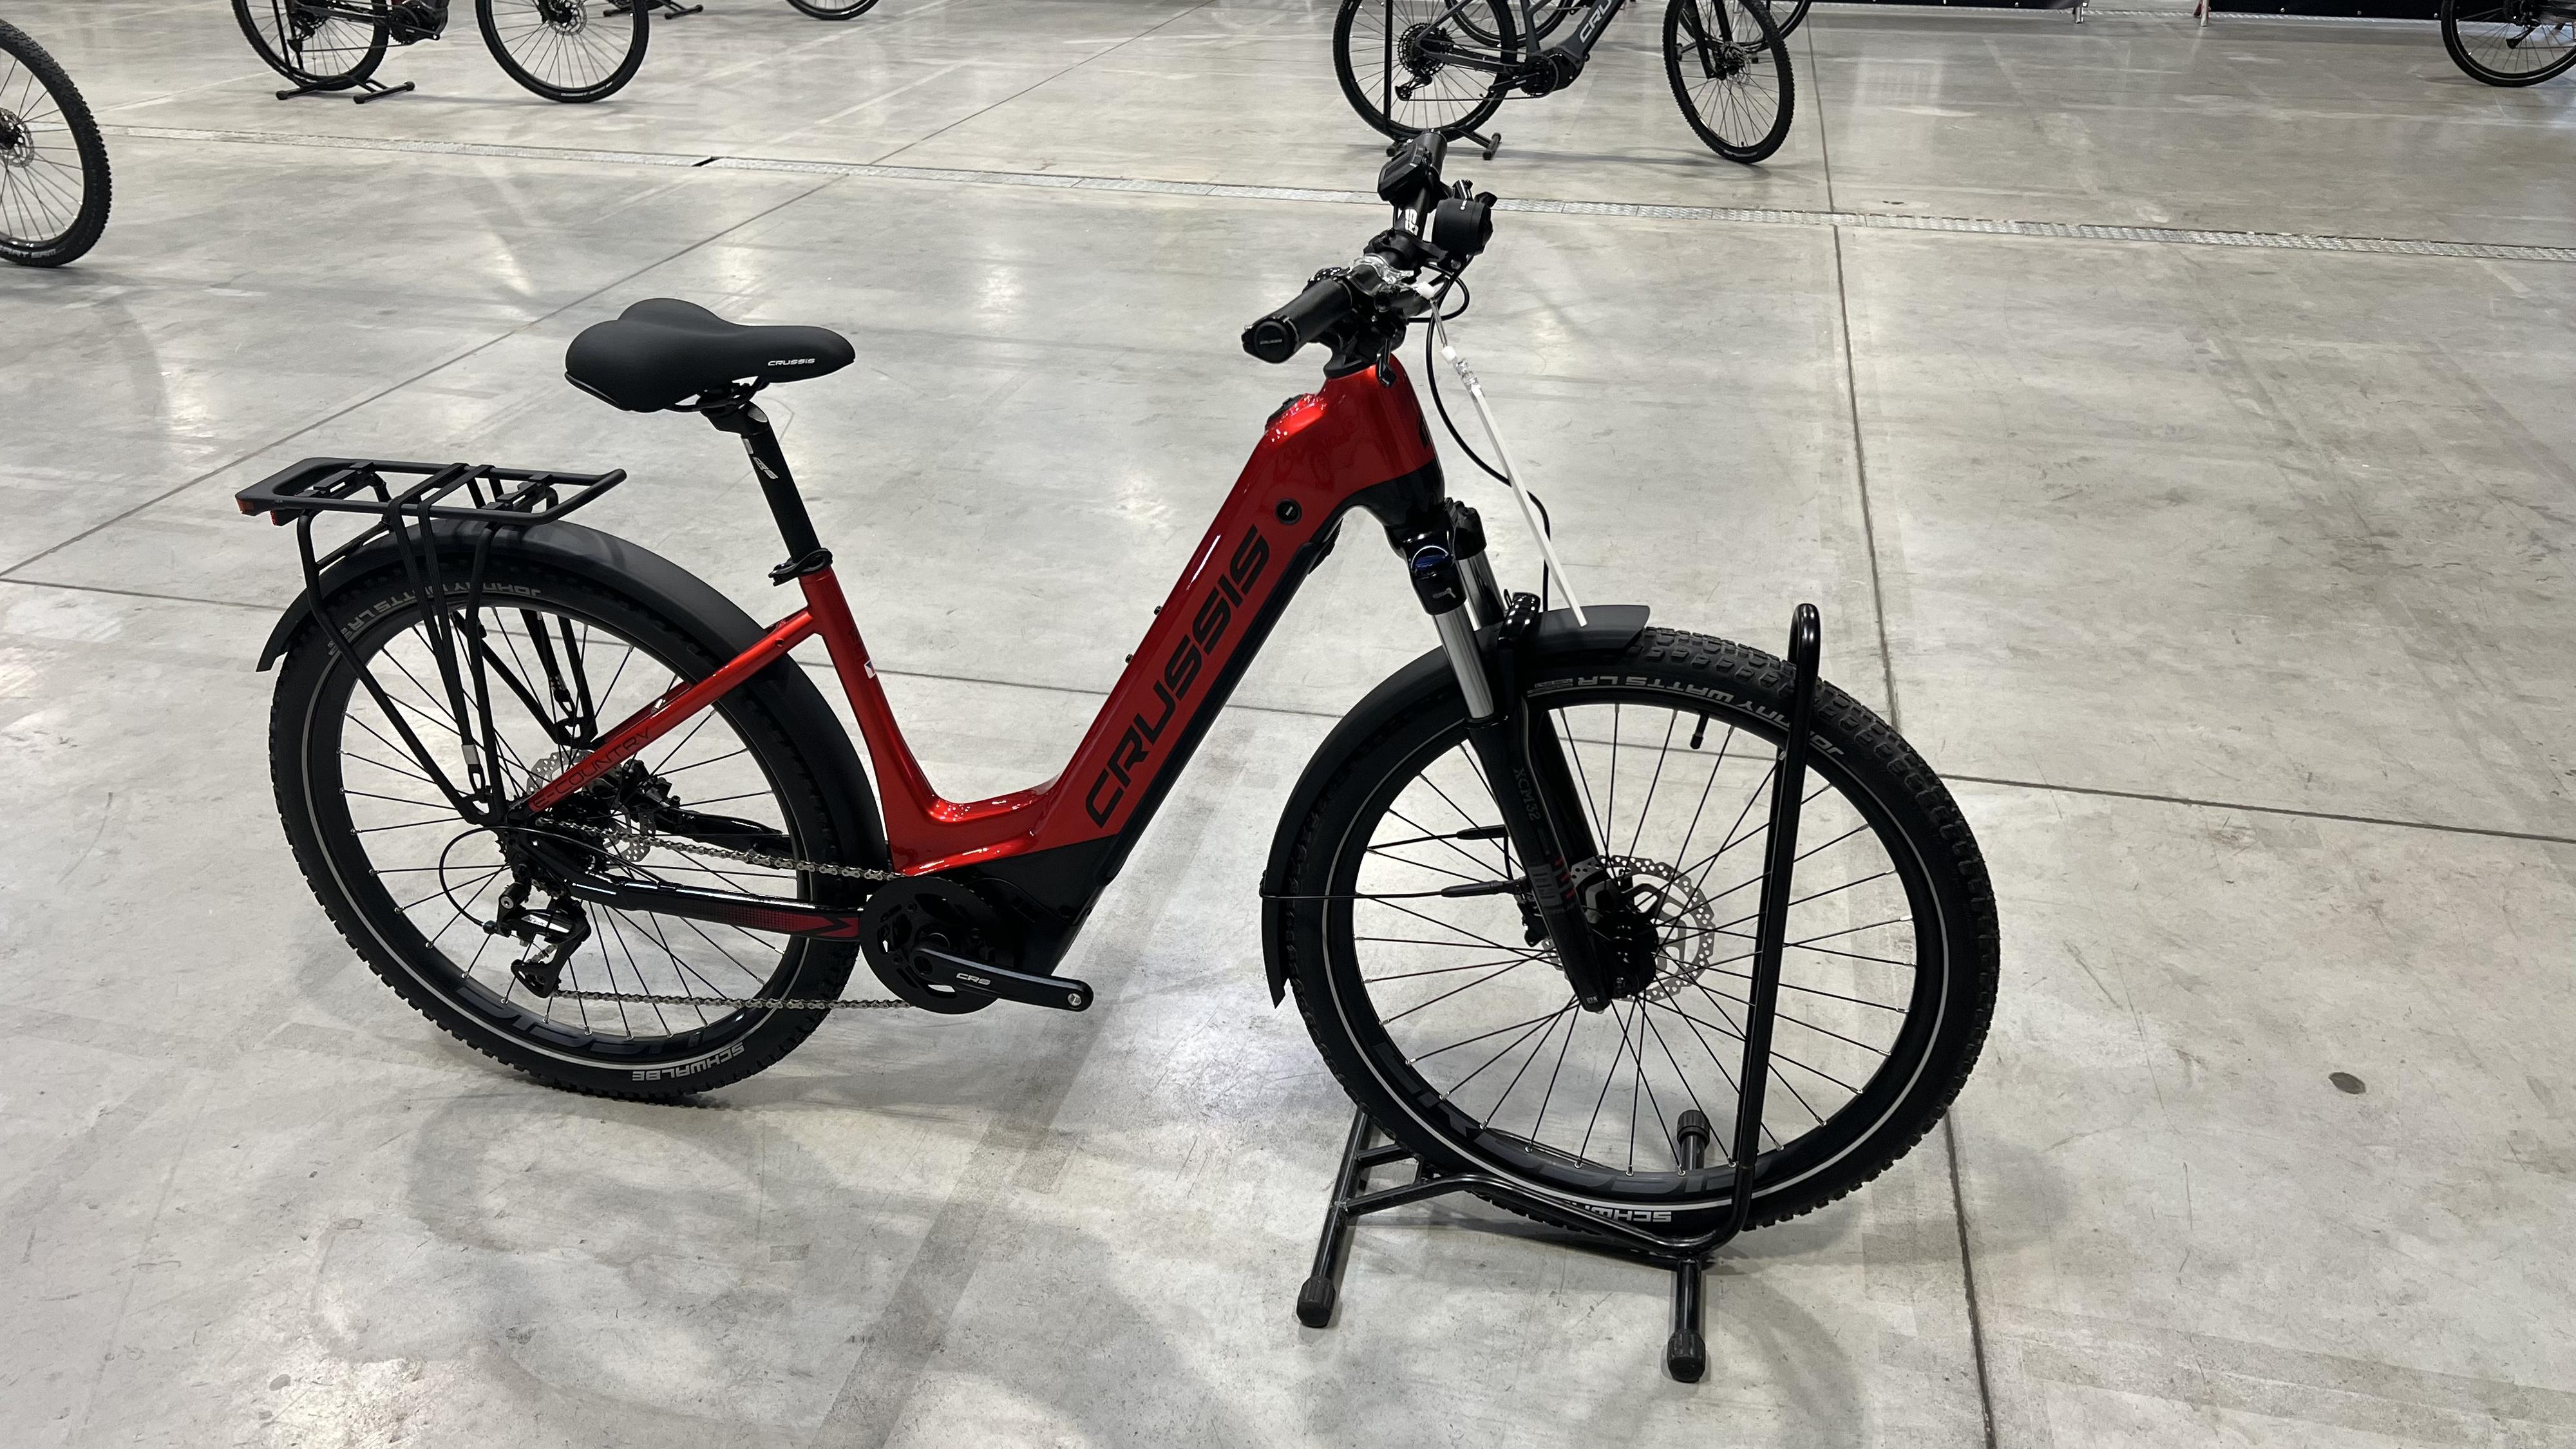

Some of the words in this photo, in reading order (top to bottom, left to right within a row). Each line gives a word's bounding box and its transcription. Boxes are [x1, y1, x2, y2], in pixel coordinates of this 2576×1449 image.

[454, 582, 542, 597] JOHNY
[1085, 524, 1270, 828] CRUSSIS
[1577, 676, 1618, 687] LR
[1624, 676, 1734, 703] WATTS
[1736, 700, 1845, 755] JONNY
[532, 726, 650, 808] E-COUNTRY
[956, 972, 991, 985] CRS
[632, 1041, 745, 1081] SCHWALBE
[1571, 1202, 1672, 1222] SCHW
